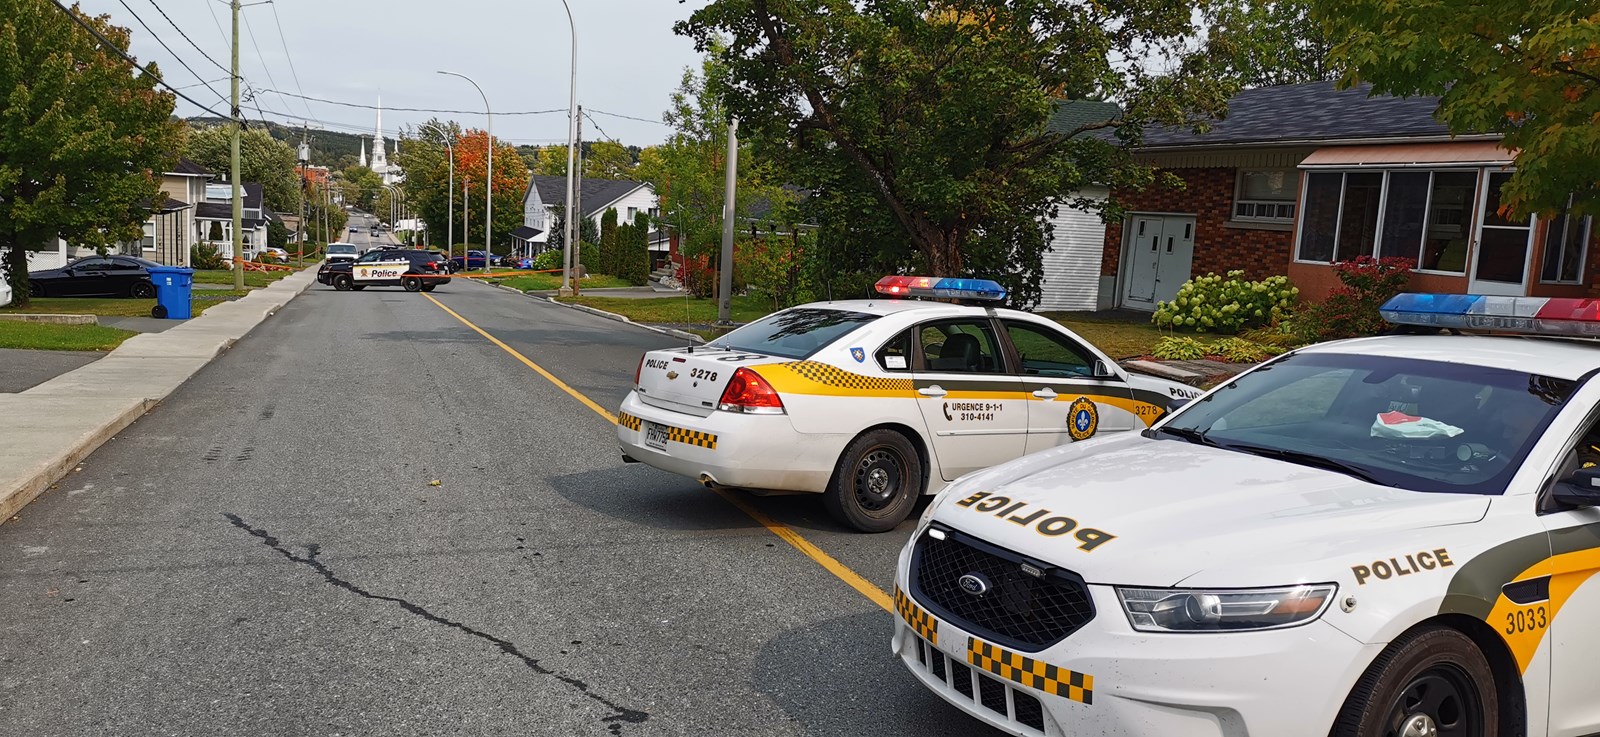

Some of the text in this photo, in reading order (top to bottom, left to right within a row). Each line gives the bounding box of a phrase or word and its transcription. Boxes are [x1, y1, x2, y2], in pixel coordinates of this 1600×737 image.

[371, 269, 398, 278] Police
[645, 359, 669, 370] POLICE
[690, 367, 718, 382] 3278
[1169, 387, 1203, 399] POLIC
[952, 403, 1003, 411] URGENCE 9-1-1
[1135, 405, 1158, 416] 3278
[960, 413, 994, 421] 310-4141
[1351, 547, 1454, 585] POLICE
[962, 578, 978, 591] Ford
[1505, 606, 1547, 635] 3033
